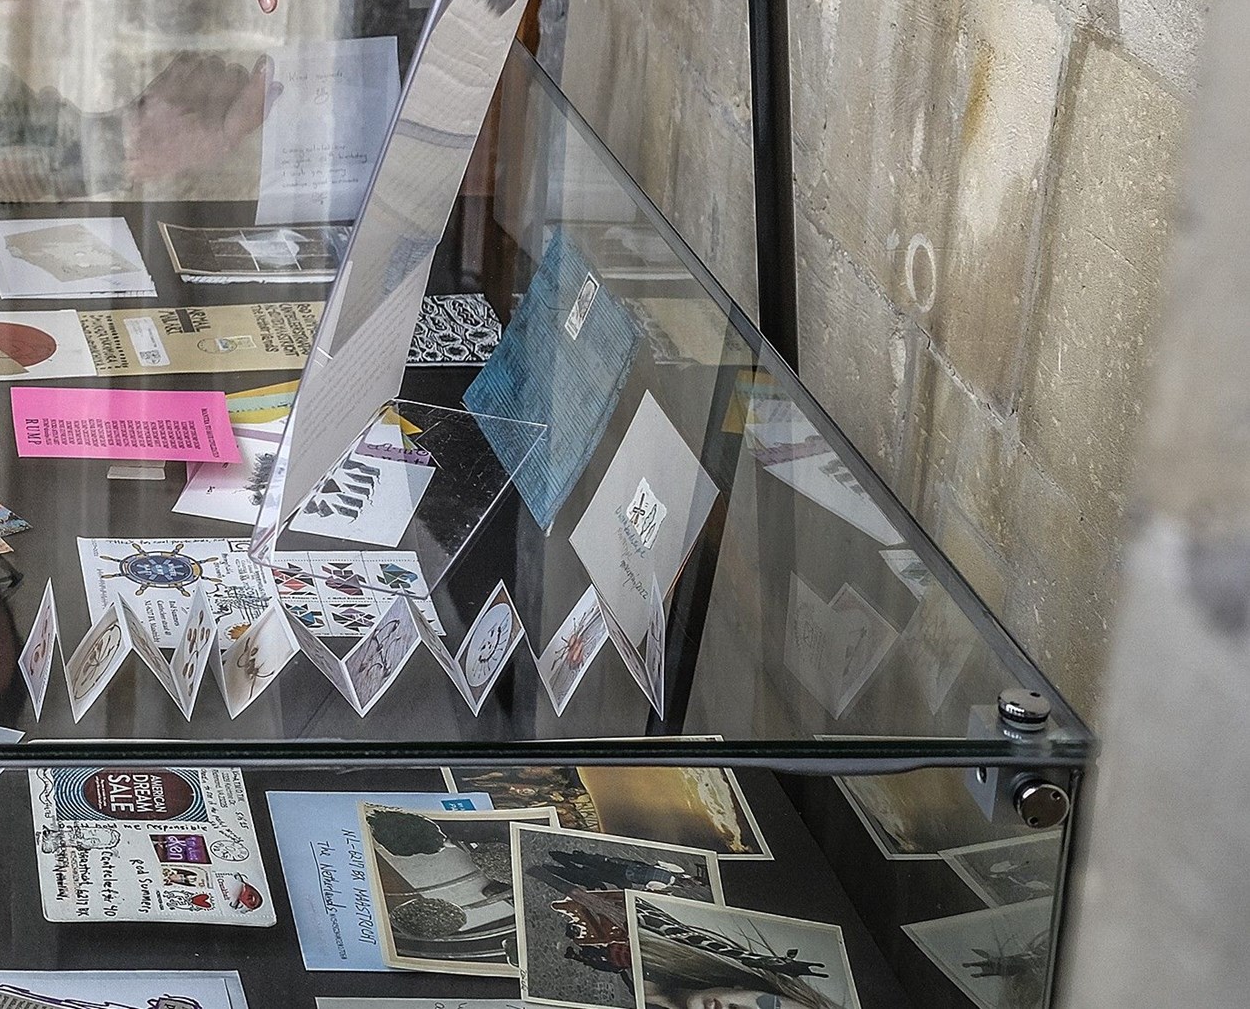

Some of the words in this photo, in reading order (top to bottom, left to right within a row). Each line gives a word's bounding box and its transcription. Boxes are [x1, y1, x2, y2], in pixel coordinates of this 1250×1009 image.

[24, 418, 41, 445] RUMP
[106, 774, 135, 811] SALE
[130, 774, 153, 812] DREAM
[149, 774, 167, 812] AMERICAN
[164, 835, 187, 860] Ken
[316, 840, 336, 856] The
[138, 879, 153, 913] Summers
[319, 863, 347, 912] Netherlands
[353, 887, 377, 945] MAASTRICHT
